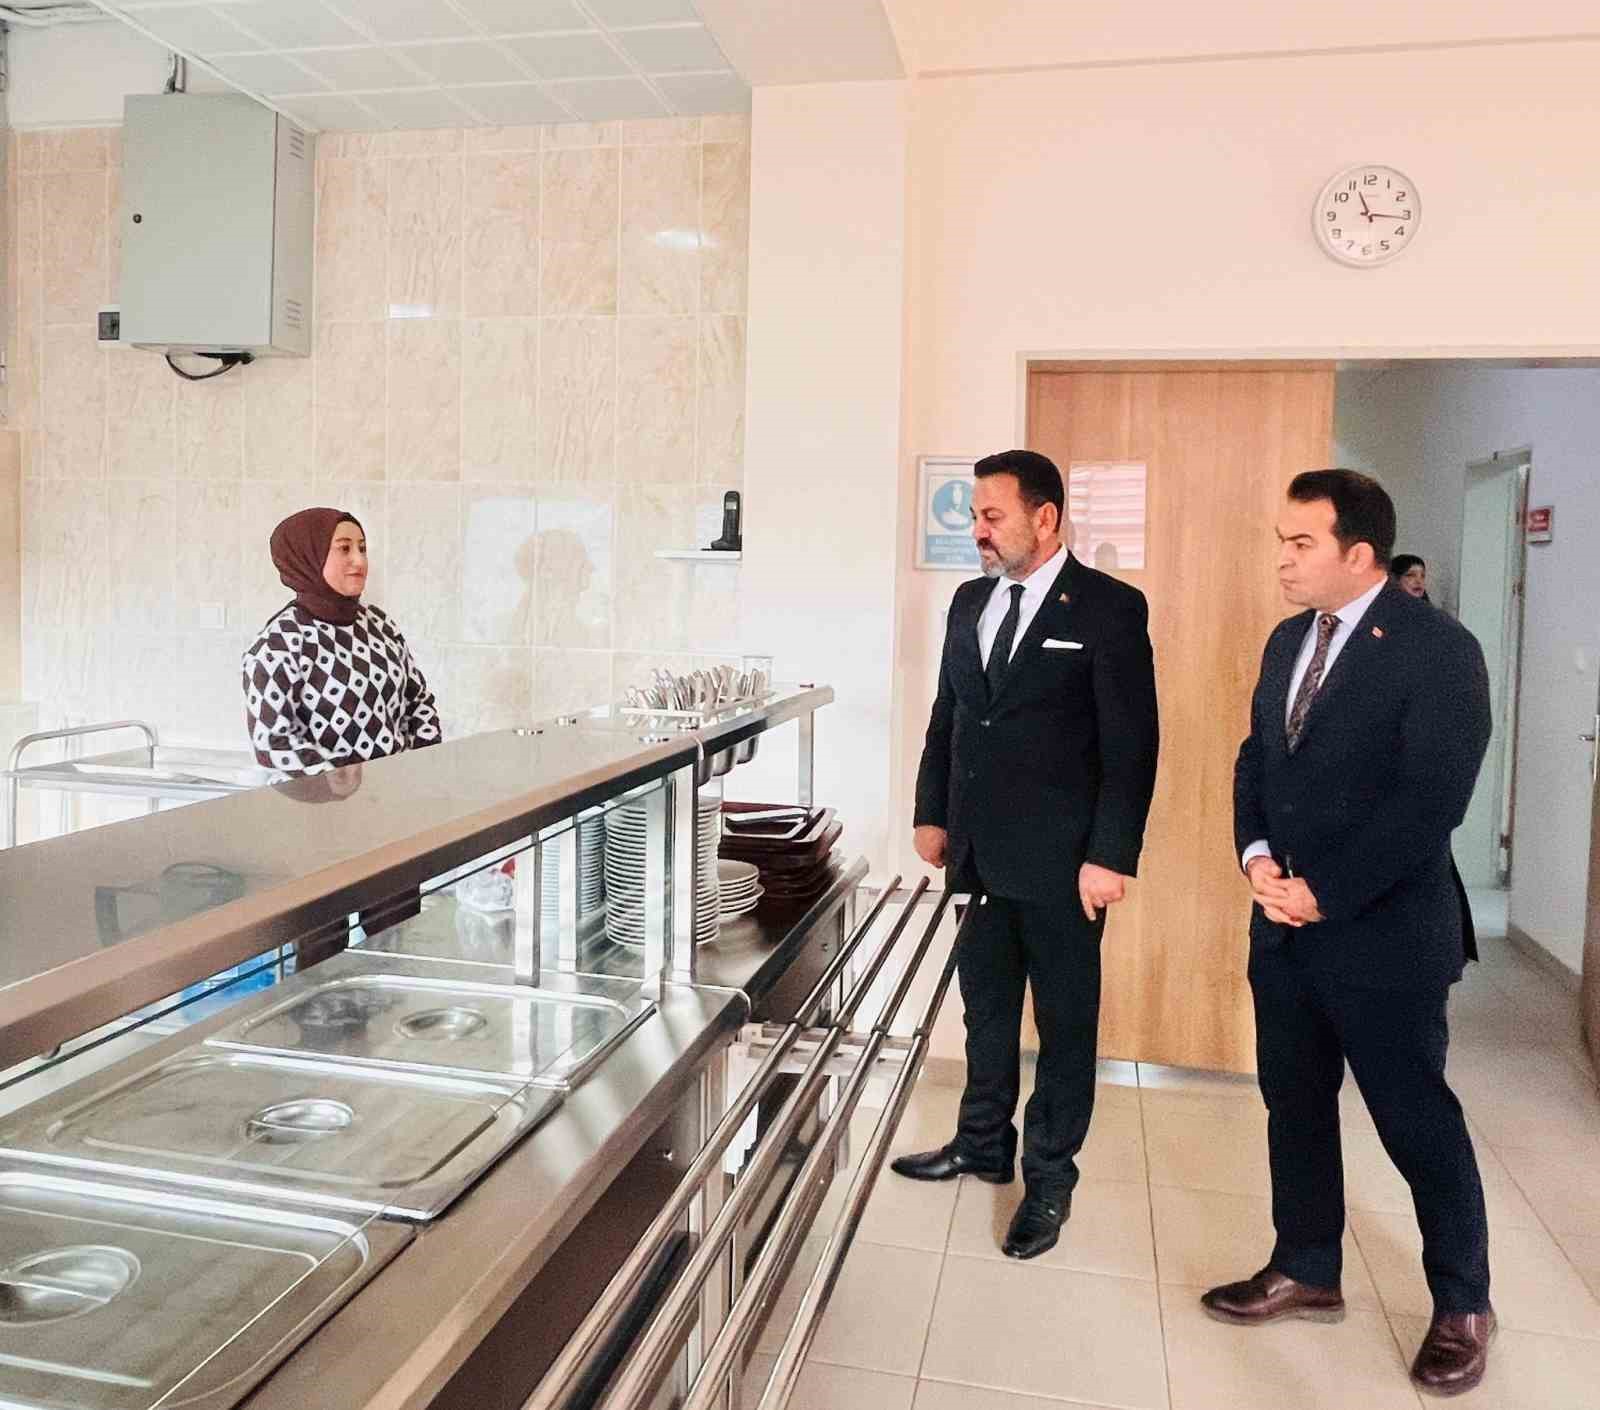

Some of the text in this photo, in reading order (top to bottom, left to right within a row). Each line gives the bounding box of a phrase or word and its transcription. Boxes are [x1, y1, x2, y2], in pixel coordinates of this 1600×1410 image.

[1348, 180, 1357, 191] 11
[1363, 174, 1378, 186] 12
[1386, 178, 1391, 189] 1
[1334, 192, 1349, 203] 10
[1396, 191, 1406, 202] 2
[1326, 211, 1337, 222] 9
[1402, 209, 1411, 221] 3
[1331, 228, 1342, 239] 8
[1394, 226, 1405, 236] 4
[1346, 240, 1355, 251] 7
[1380, 240, 1390, 251] 5
